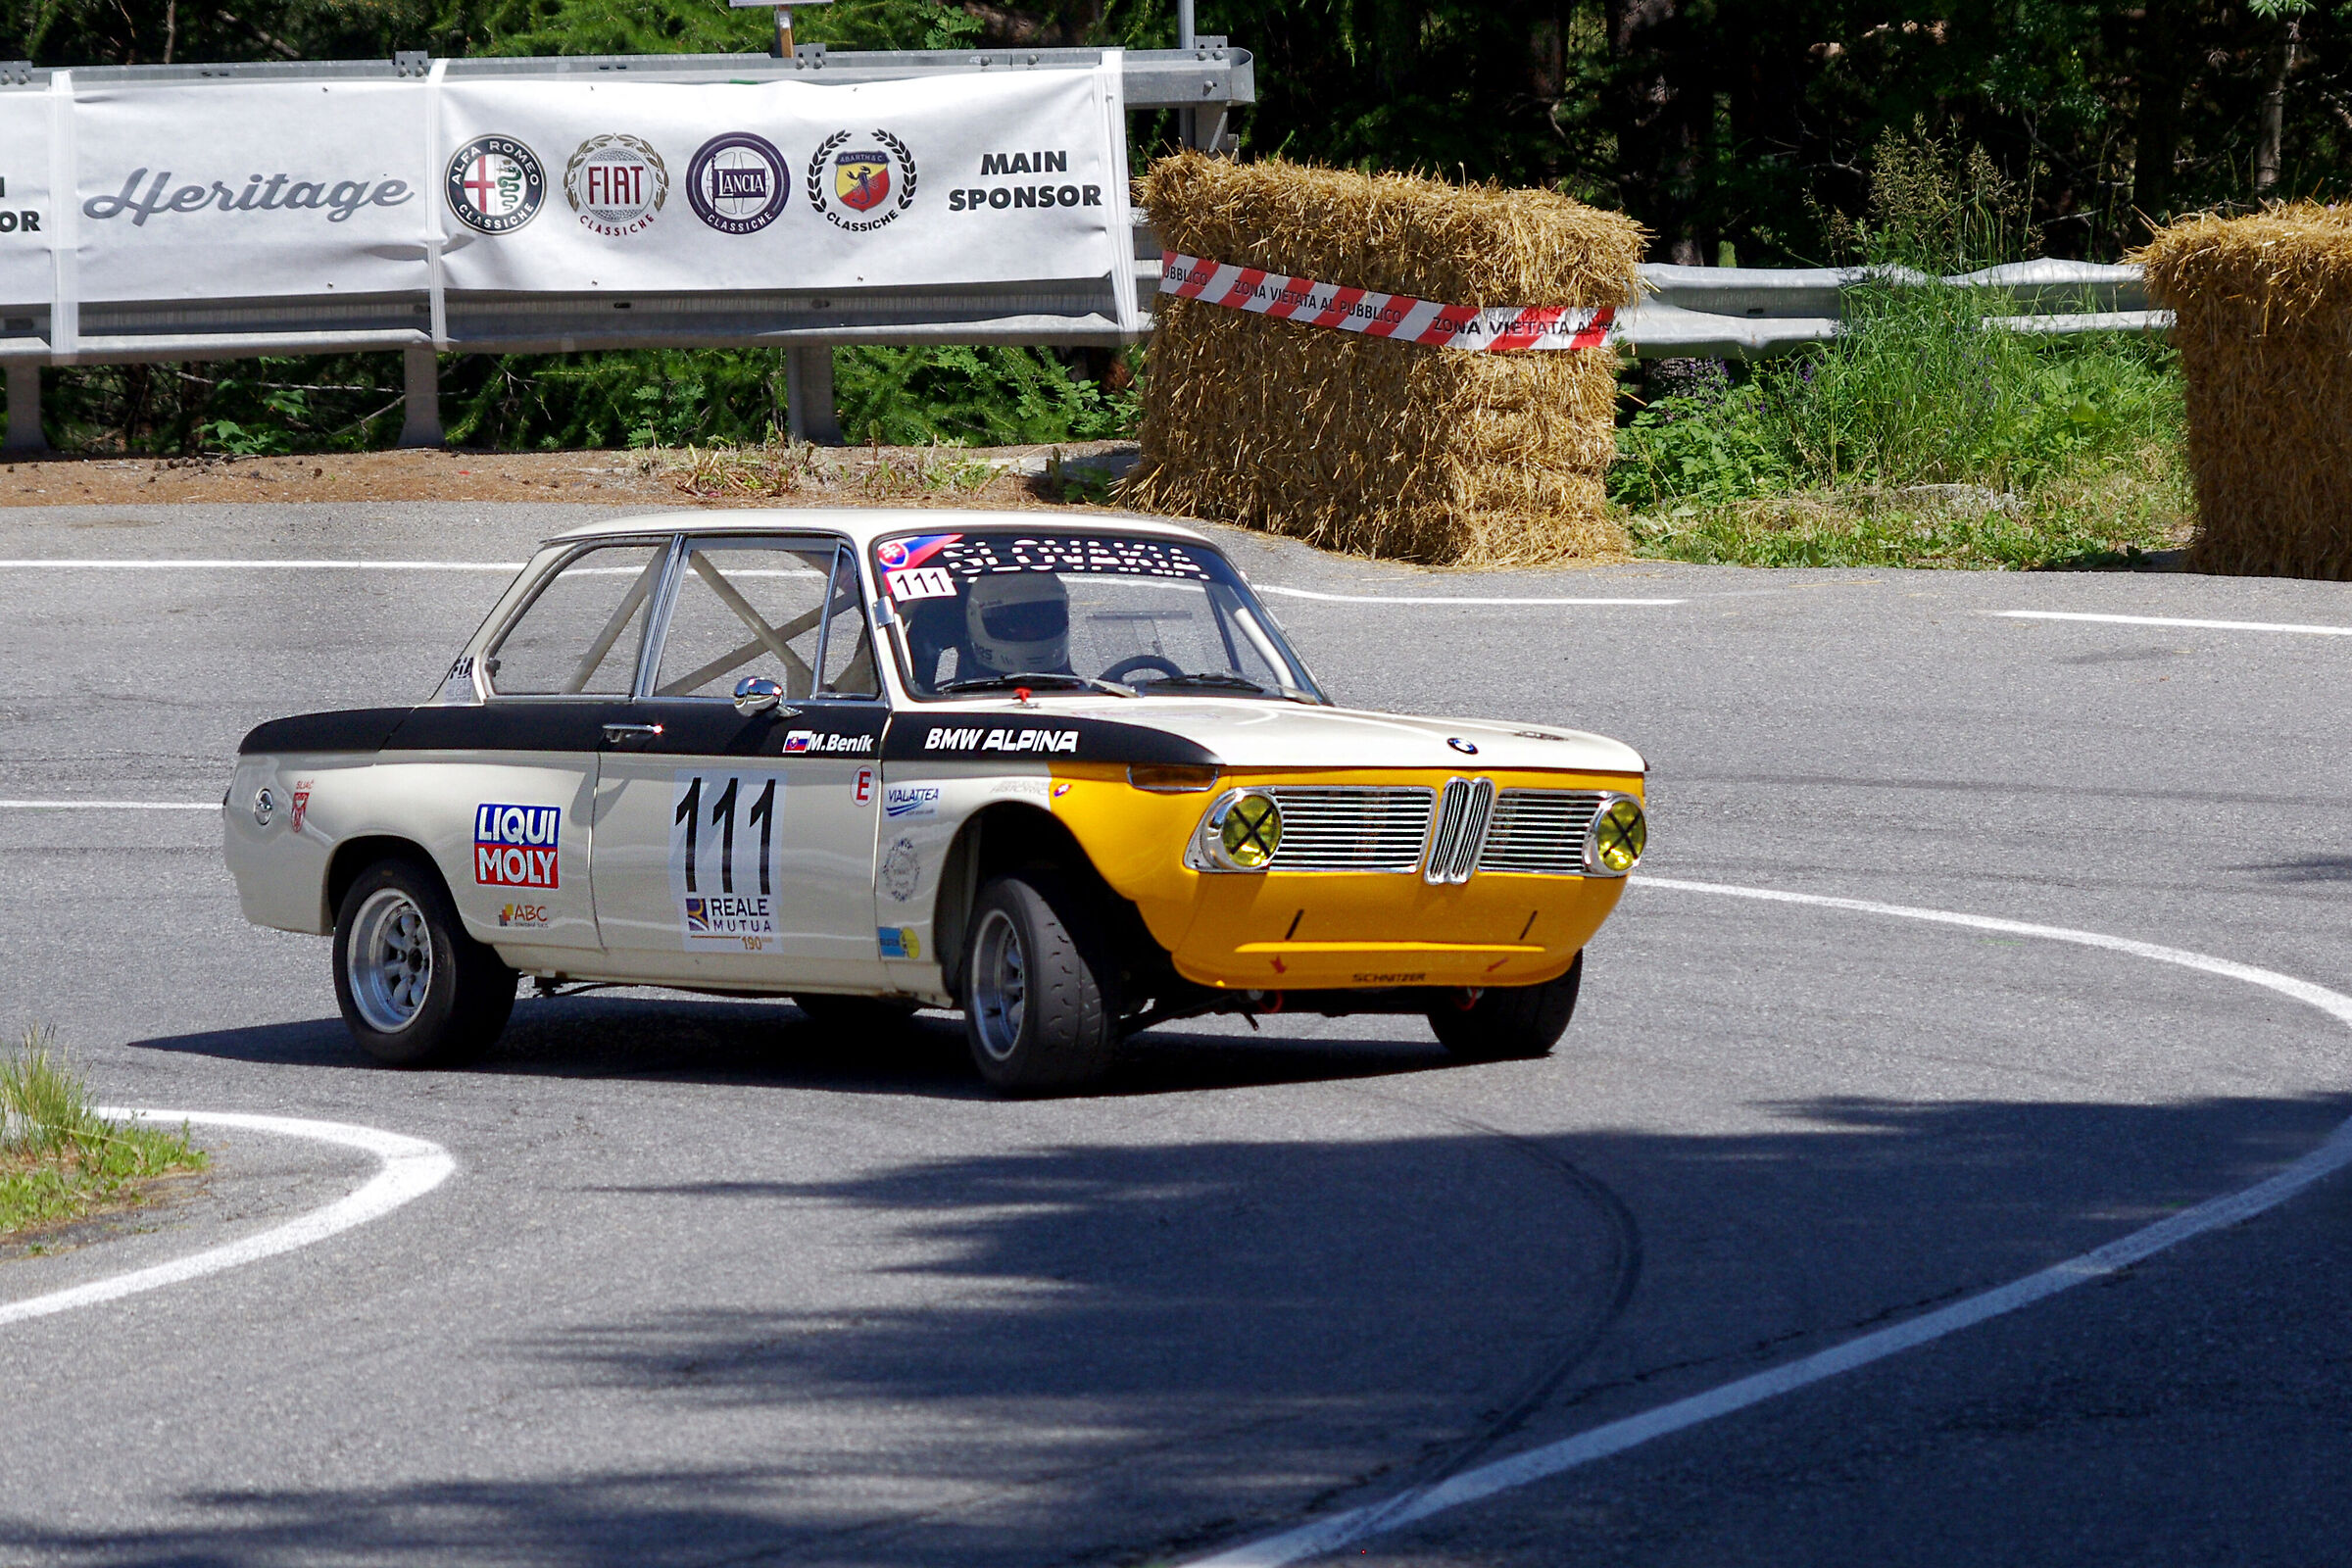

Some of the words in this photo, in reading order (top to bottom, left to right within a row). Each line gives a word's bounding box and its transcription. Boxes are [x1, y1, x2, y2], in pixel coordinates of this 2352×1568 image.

[452, 146, 481, 184] ALFA
[489, 140, 539, 186] ROMEO
[981, 150, 1067, 174] MAIN
[588, 166, 644, 205] FIAT
[718, 170, 764, 197] LANCIA
[83, 168, 414, 226] Heritage
[949, 184, 1102, 212] SPONSOR
[458, 202, 535, 228] CLASSICHE
[580, 213, 655, 237] CLASSICHE
[708, 210, 773, 231] CLASSICHE
[826, 209, 899, 232] CLASSICHE
[1234, 279, 1266, 300] ZONA
[1270, 286, 1317, 310] VIETATA
[1320, 297, 1336, 313] AL
[1339, 301, 1401, 324] PUBBLICO
[1433, 316, 1482, 336] ZONA
[1489, 320, 1570, 336] VIETATA
[896, 571, 947, 596] 111
[924, 728, 984, 751] BMW
[981, 729, 1078, 753] ALPINA
[856, 770, 872, 801] E
[478, 807, 558, 846] LIQUI
[674, 777, 776, 896] 111
[478, 847, 557, 884] MOLY
[514, 905, 548, 922] ABC
[710, 898, 769, 916] REALE
[713, 919, 771, 932] MUTUA
